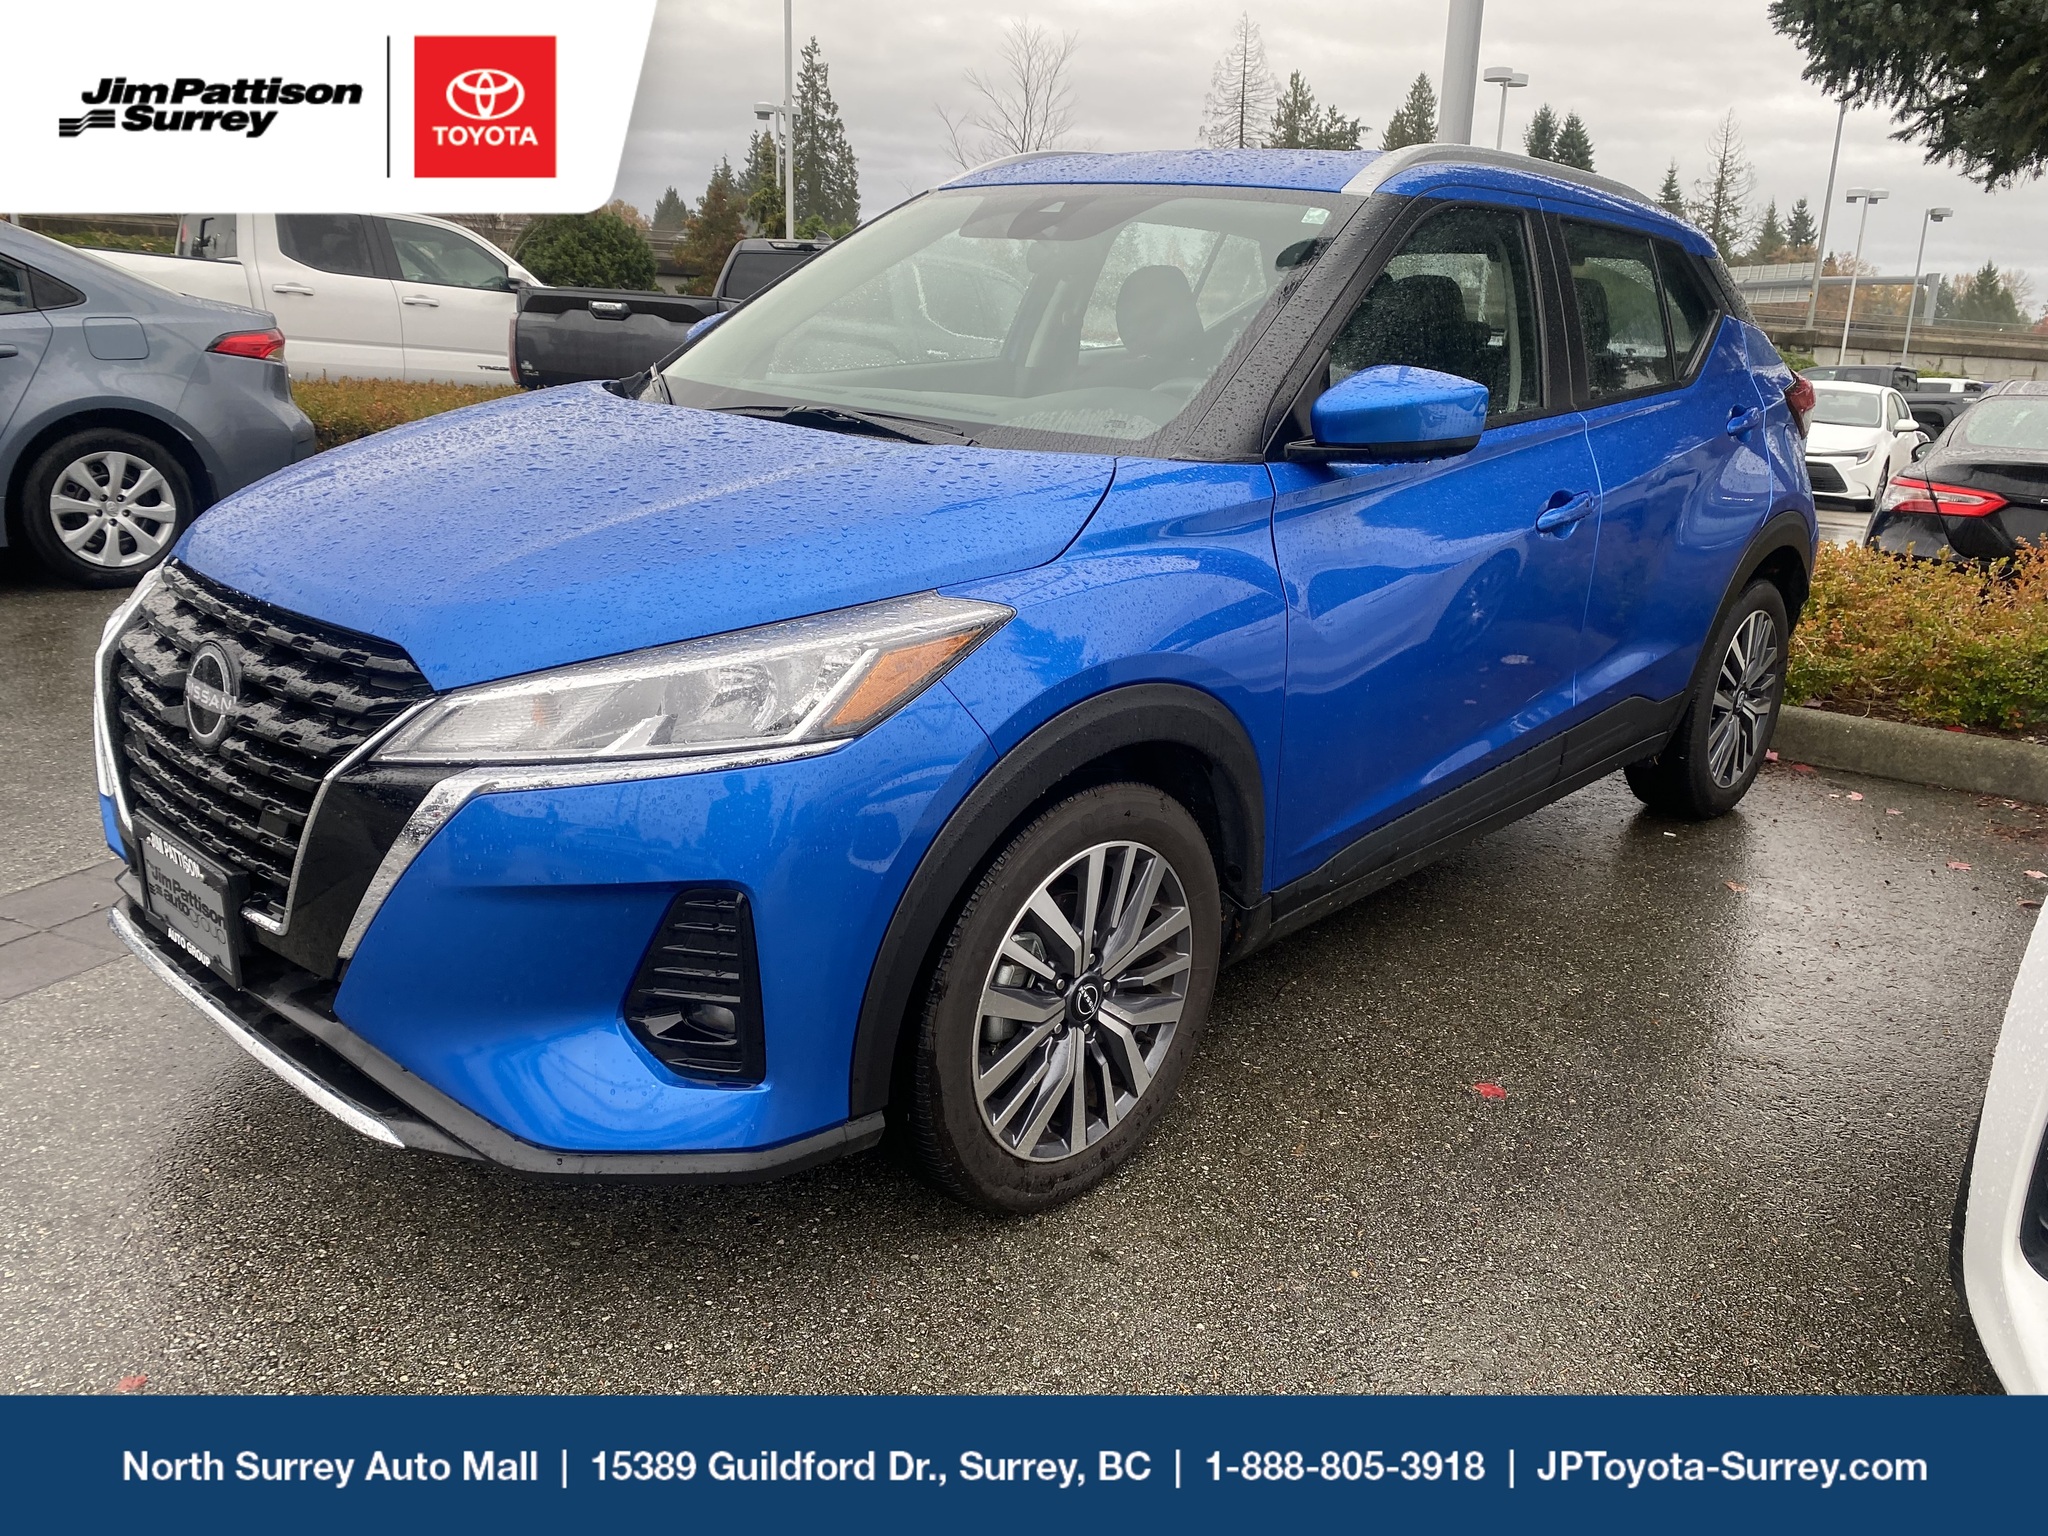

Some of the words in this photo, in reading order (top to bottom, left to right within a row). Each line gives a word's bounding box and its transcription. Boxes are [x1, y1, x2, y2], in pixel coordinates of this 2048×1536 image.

[163, 840, 201, 878] PATTISON
[168, 927, 186, 950] AUTO
[186, 941, 211, 968] GROUP
